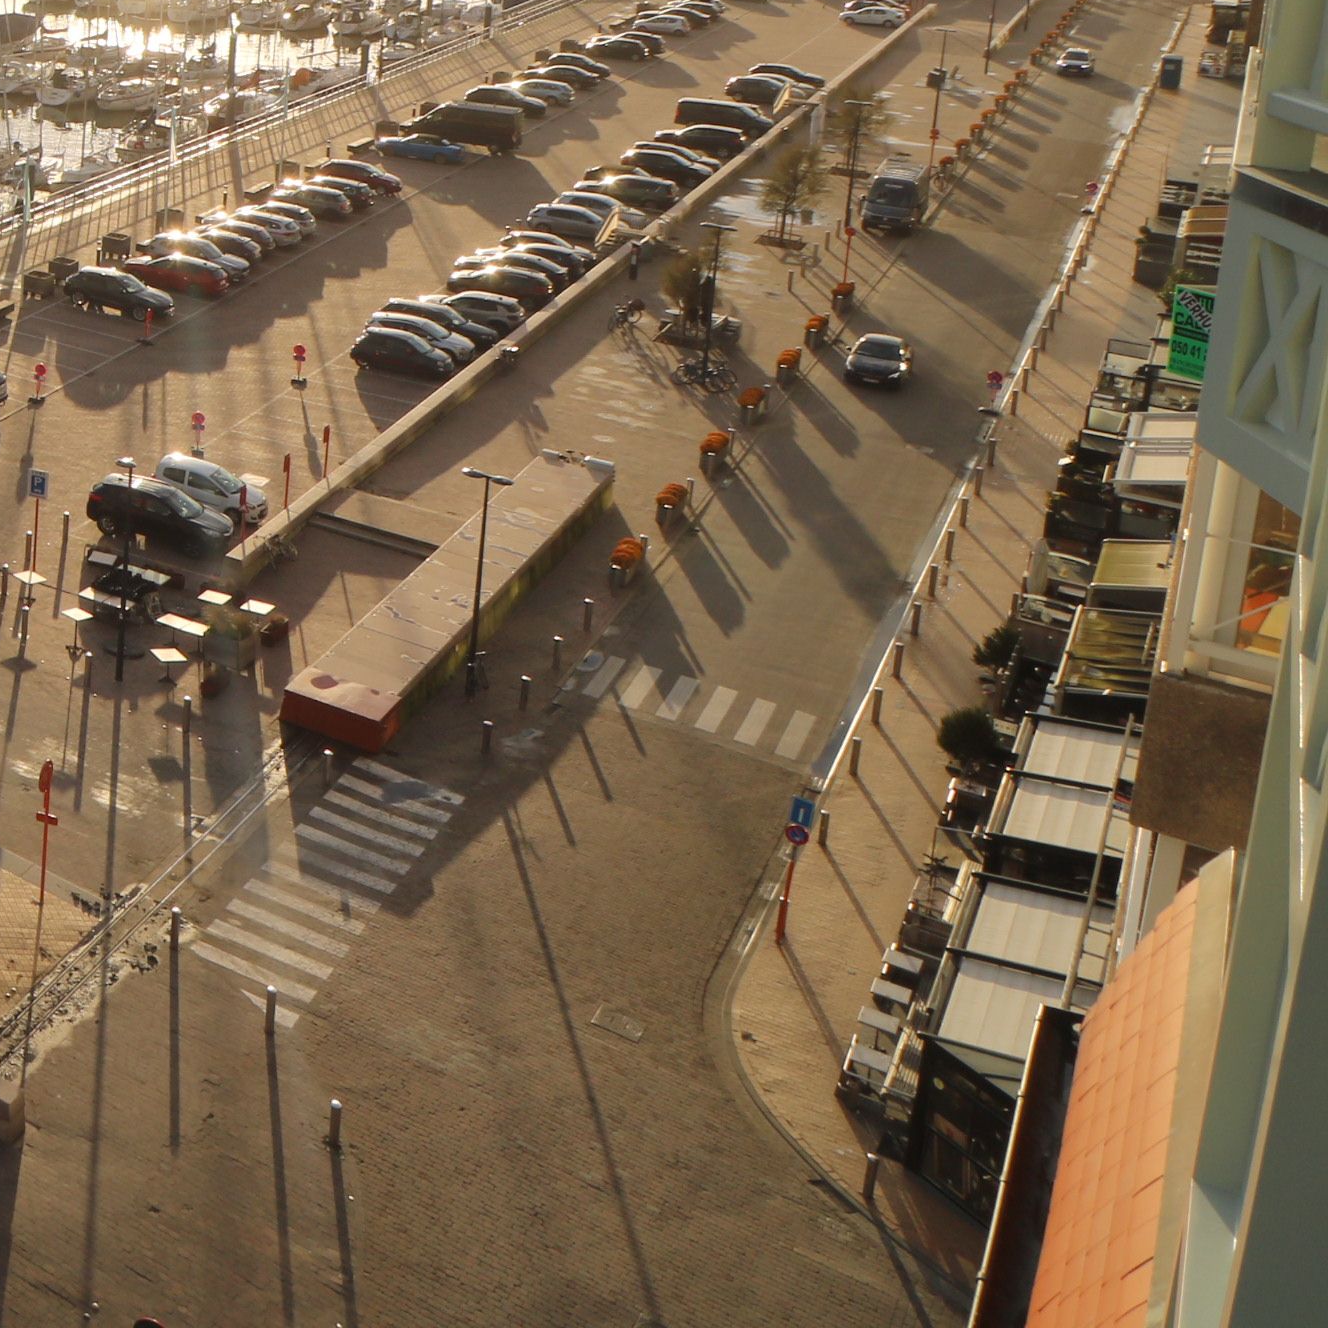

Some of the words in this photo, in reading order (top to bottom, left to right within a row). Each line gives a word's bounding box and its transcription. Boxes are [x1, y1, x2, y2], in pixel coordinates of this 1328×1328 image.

[1172, 340, 1188, 356] 050
[1190, 345, 1201, 360] 41
[34, 476, 43, 487] P
